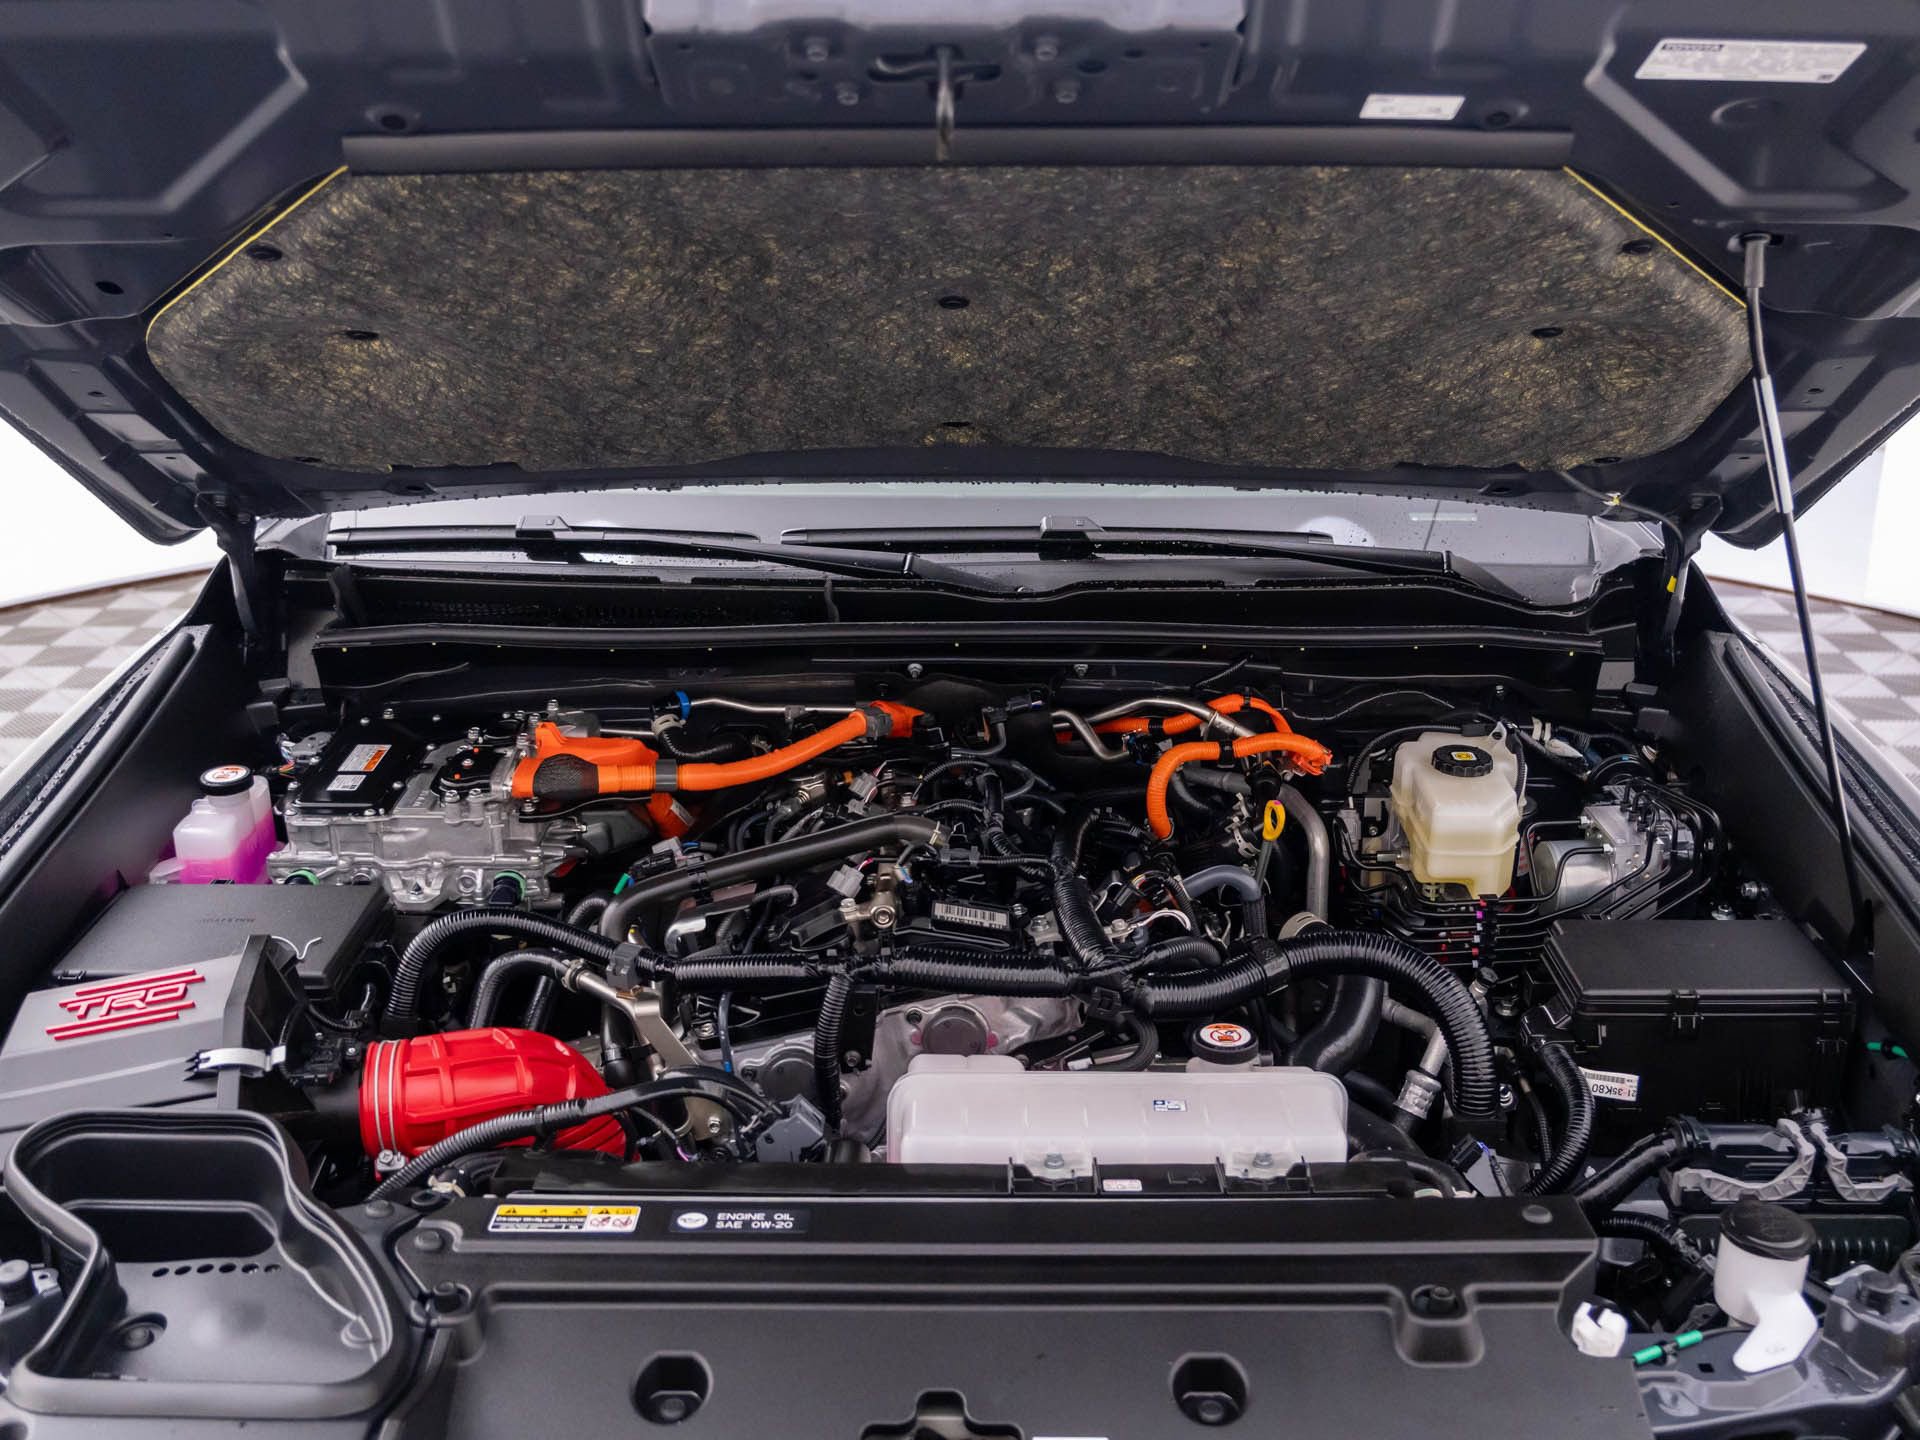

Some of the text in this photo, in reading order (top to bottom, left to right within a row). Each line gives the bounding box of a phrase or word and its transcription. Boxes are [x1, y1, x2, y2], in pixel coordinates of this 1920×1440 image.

[66, 983, 188, 1019] TRD
[716, 1212, 795, 1221] ENGINE OIL
[715, 1220, 793, 1229] SAE 0W-20
